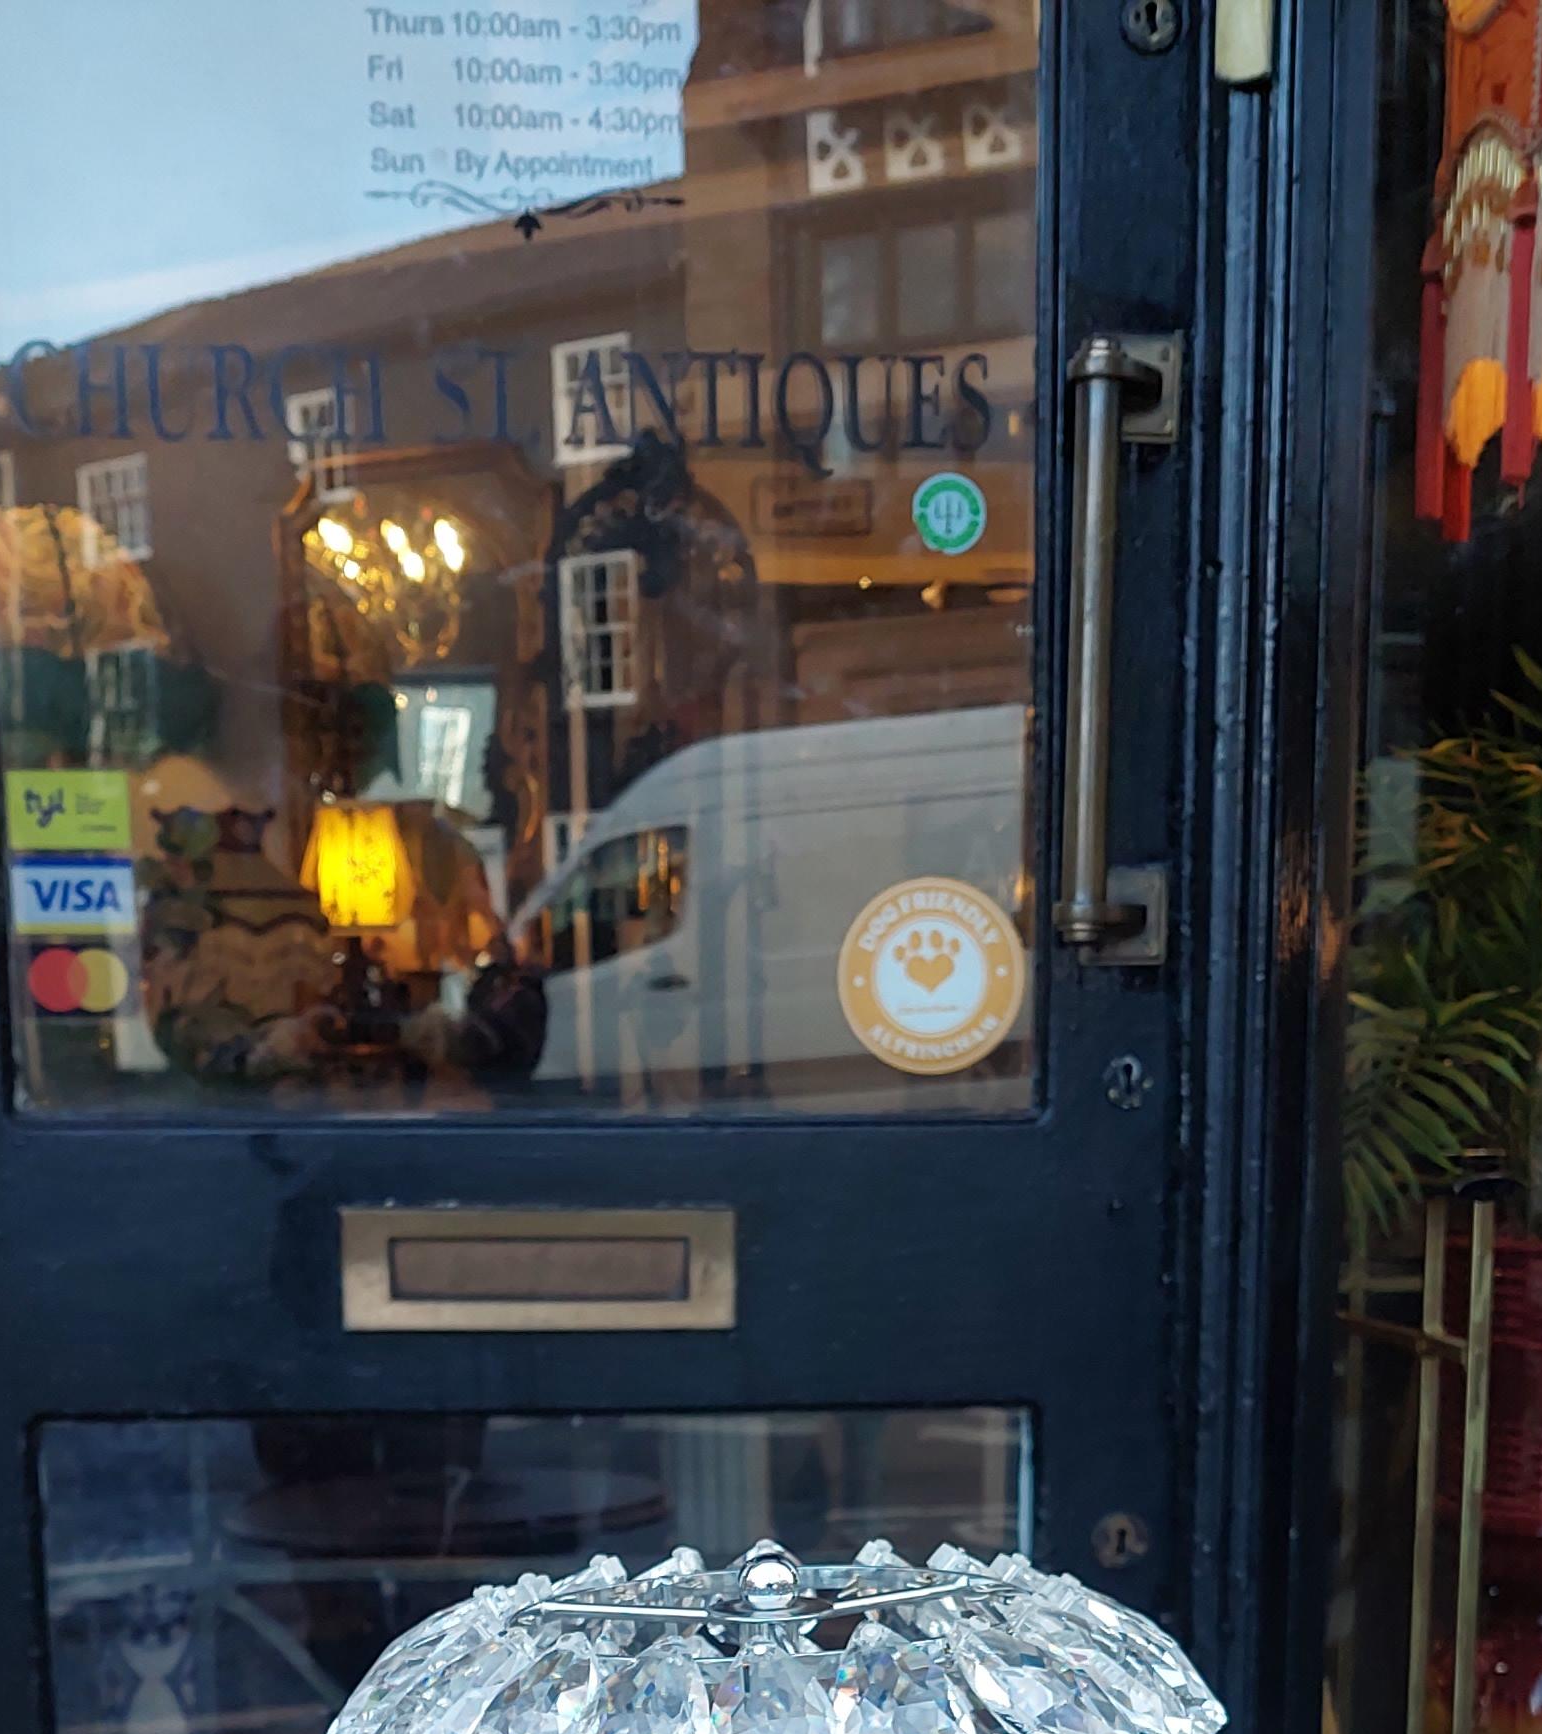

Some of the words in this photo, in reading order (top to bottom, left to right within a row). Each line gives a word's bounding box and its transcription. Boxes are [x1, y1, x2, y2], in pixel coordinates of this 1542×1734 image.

[364, 7, 444, 36] Thurs
[453, 10, 561, 41] 10:00am
[586, 14, 681, 48] 3:30pm
[367, 54, 403, 82] Fri
[454, 56, 563, 85] 10:00am
[588, 60, 684, 94] 3:30pm
[369, 101, 416, 129] Sat
[455, 103, 563, 132] 10:00am
[588, 106, 684, 141] 4:30pm
[370, 147, 425, 174] Sun
[455, 149, 488, 181] By
[494, 150, 653, 182] Appointment
[8, 339, 387, 443] CHURCH
[563, 348, 992, 480] ANTIQUES
[26, 878, 122, 912] VISA
